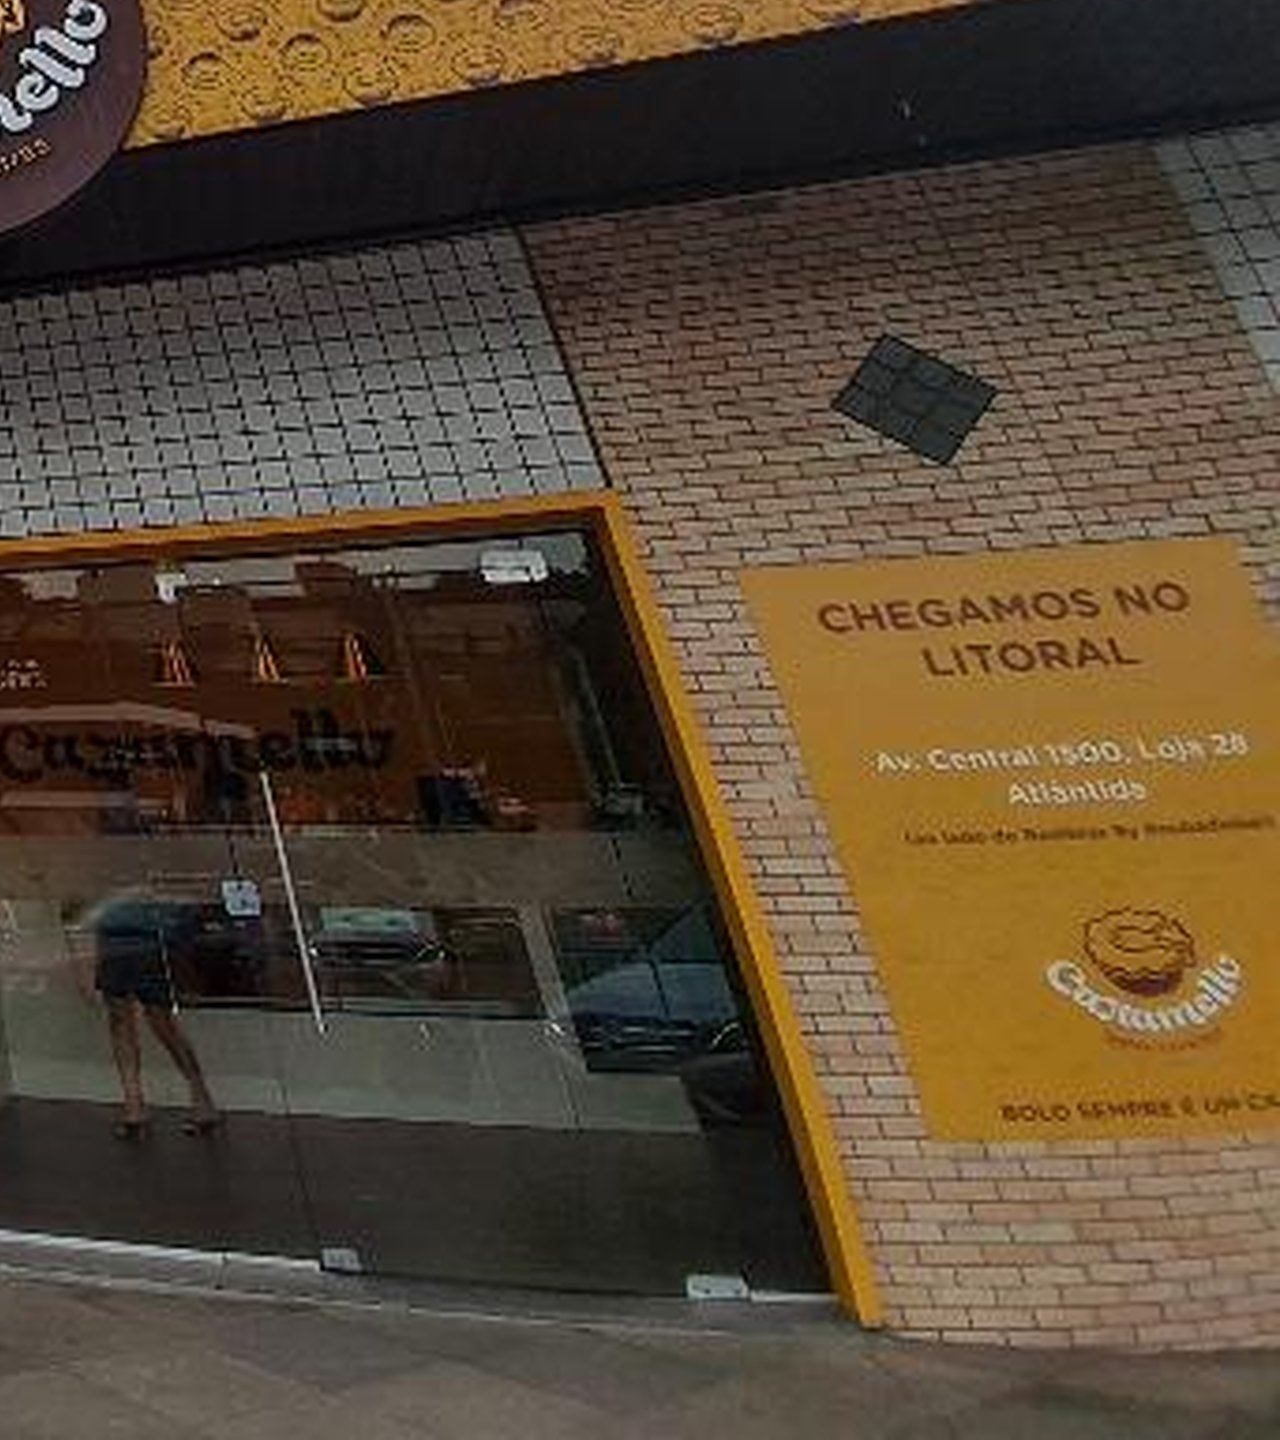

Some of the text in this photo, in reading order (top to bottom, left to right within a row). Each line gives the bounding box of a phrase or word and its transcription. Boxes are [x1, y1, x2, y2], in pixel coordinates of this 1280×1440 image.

[818, 580, 1192, 634] CHEGAMOS NO
[923, 636, 1141, 677] LITORAL
[875, 751, 923, 775] Av.
[933, 746, 1039, 772] Central
[1139, 736, 1205, 763] Loja
[1046, 954, 1241, 1033] Caramello
[1001, 1103, 1072, 1123] BOLO
